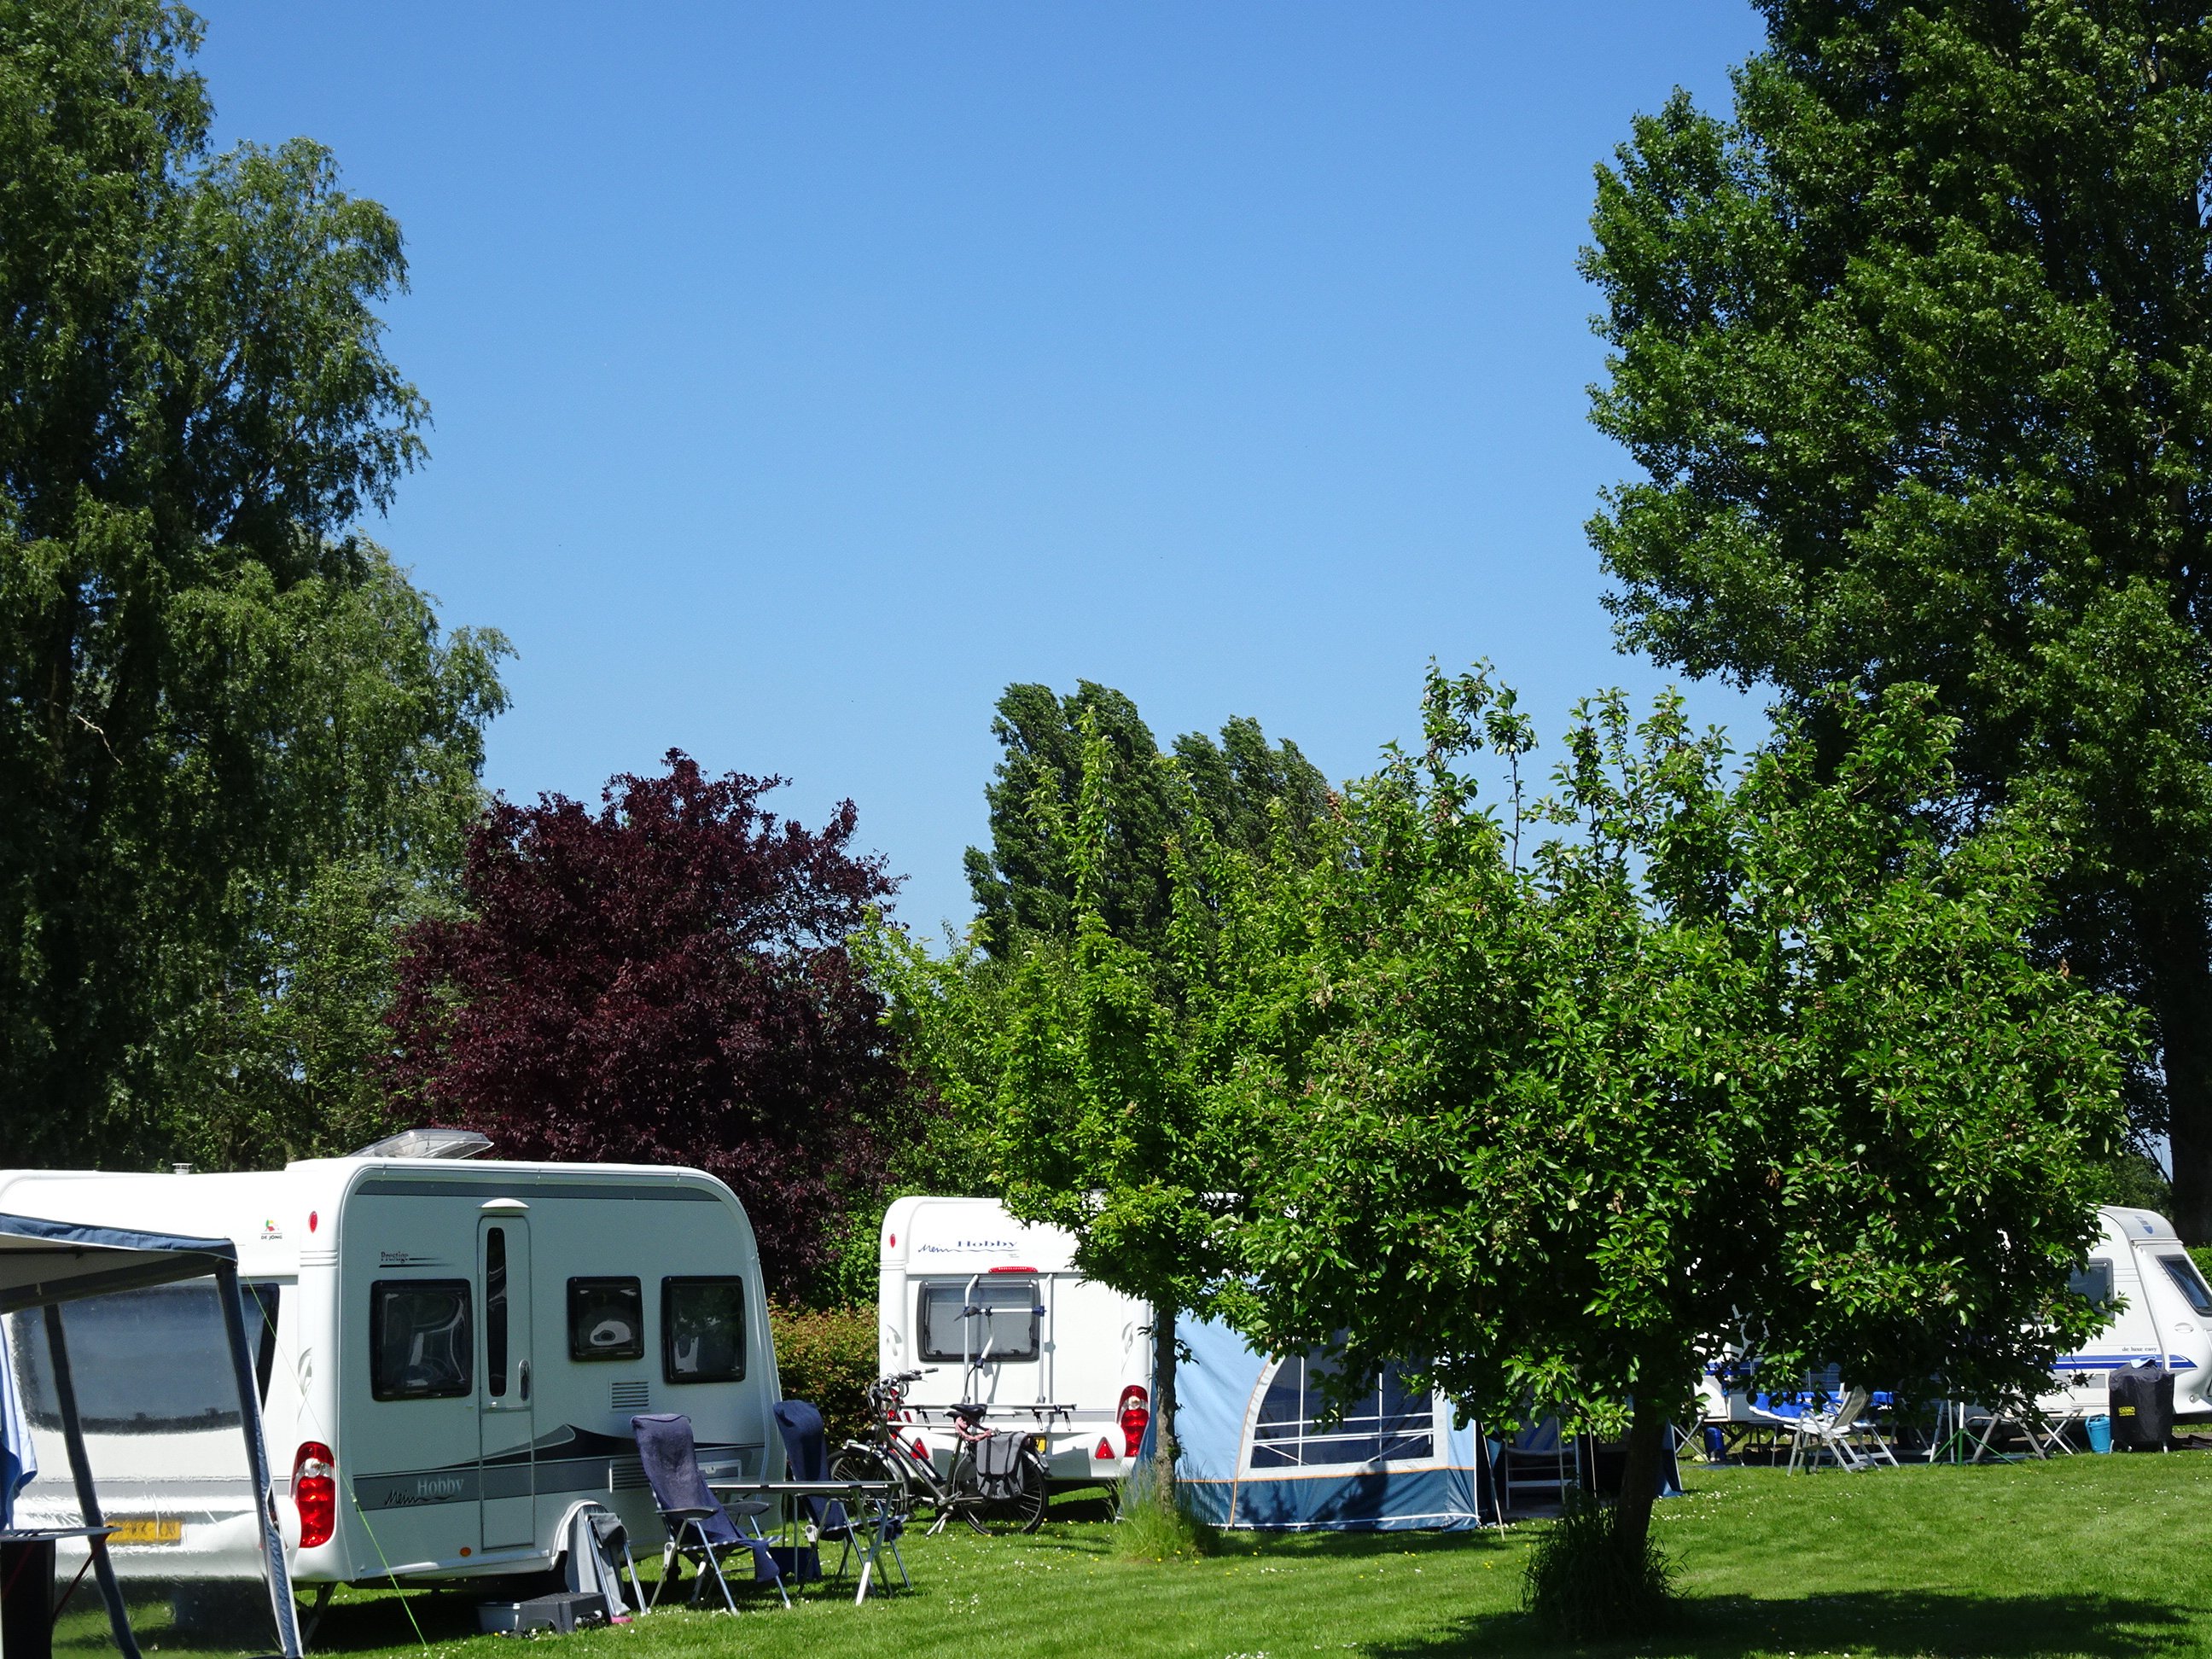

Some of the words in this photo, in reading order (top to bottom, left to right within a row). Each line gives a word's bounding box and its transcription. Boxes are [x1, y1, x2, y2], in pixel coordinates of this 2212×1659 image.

[918, 1244, 950, 1253] Mein
[958, 1240, 1018, 1249] Hobby
[381, 1251, 409, 1263] Prestige
[385, 1489, 419, 1506] Mein
[417, 1477, 464, 1497] Hobby
